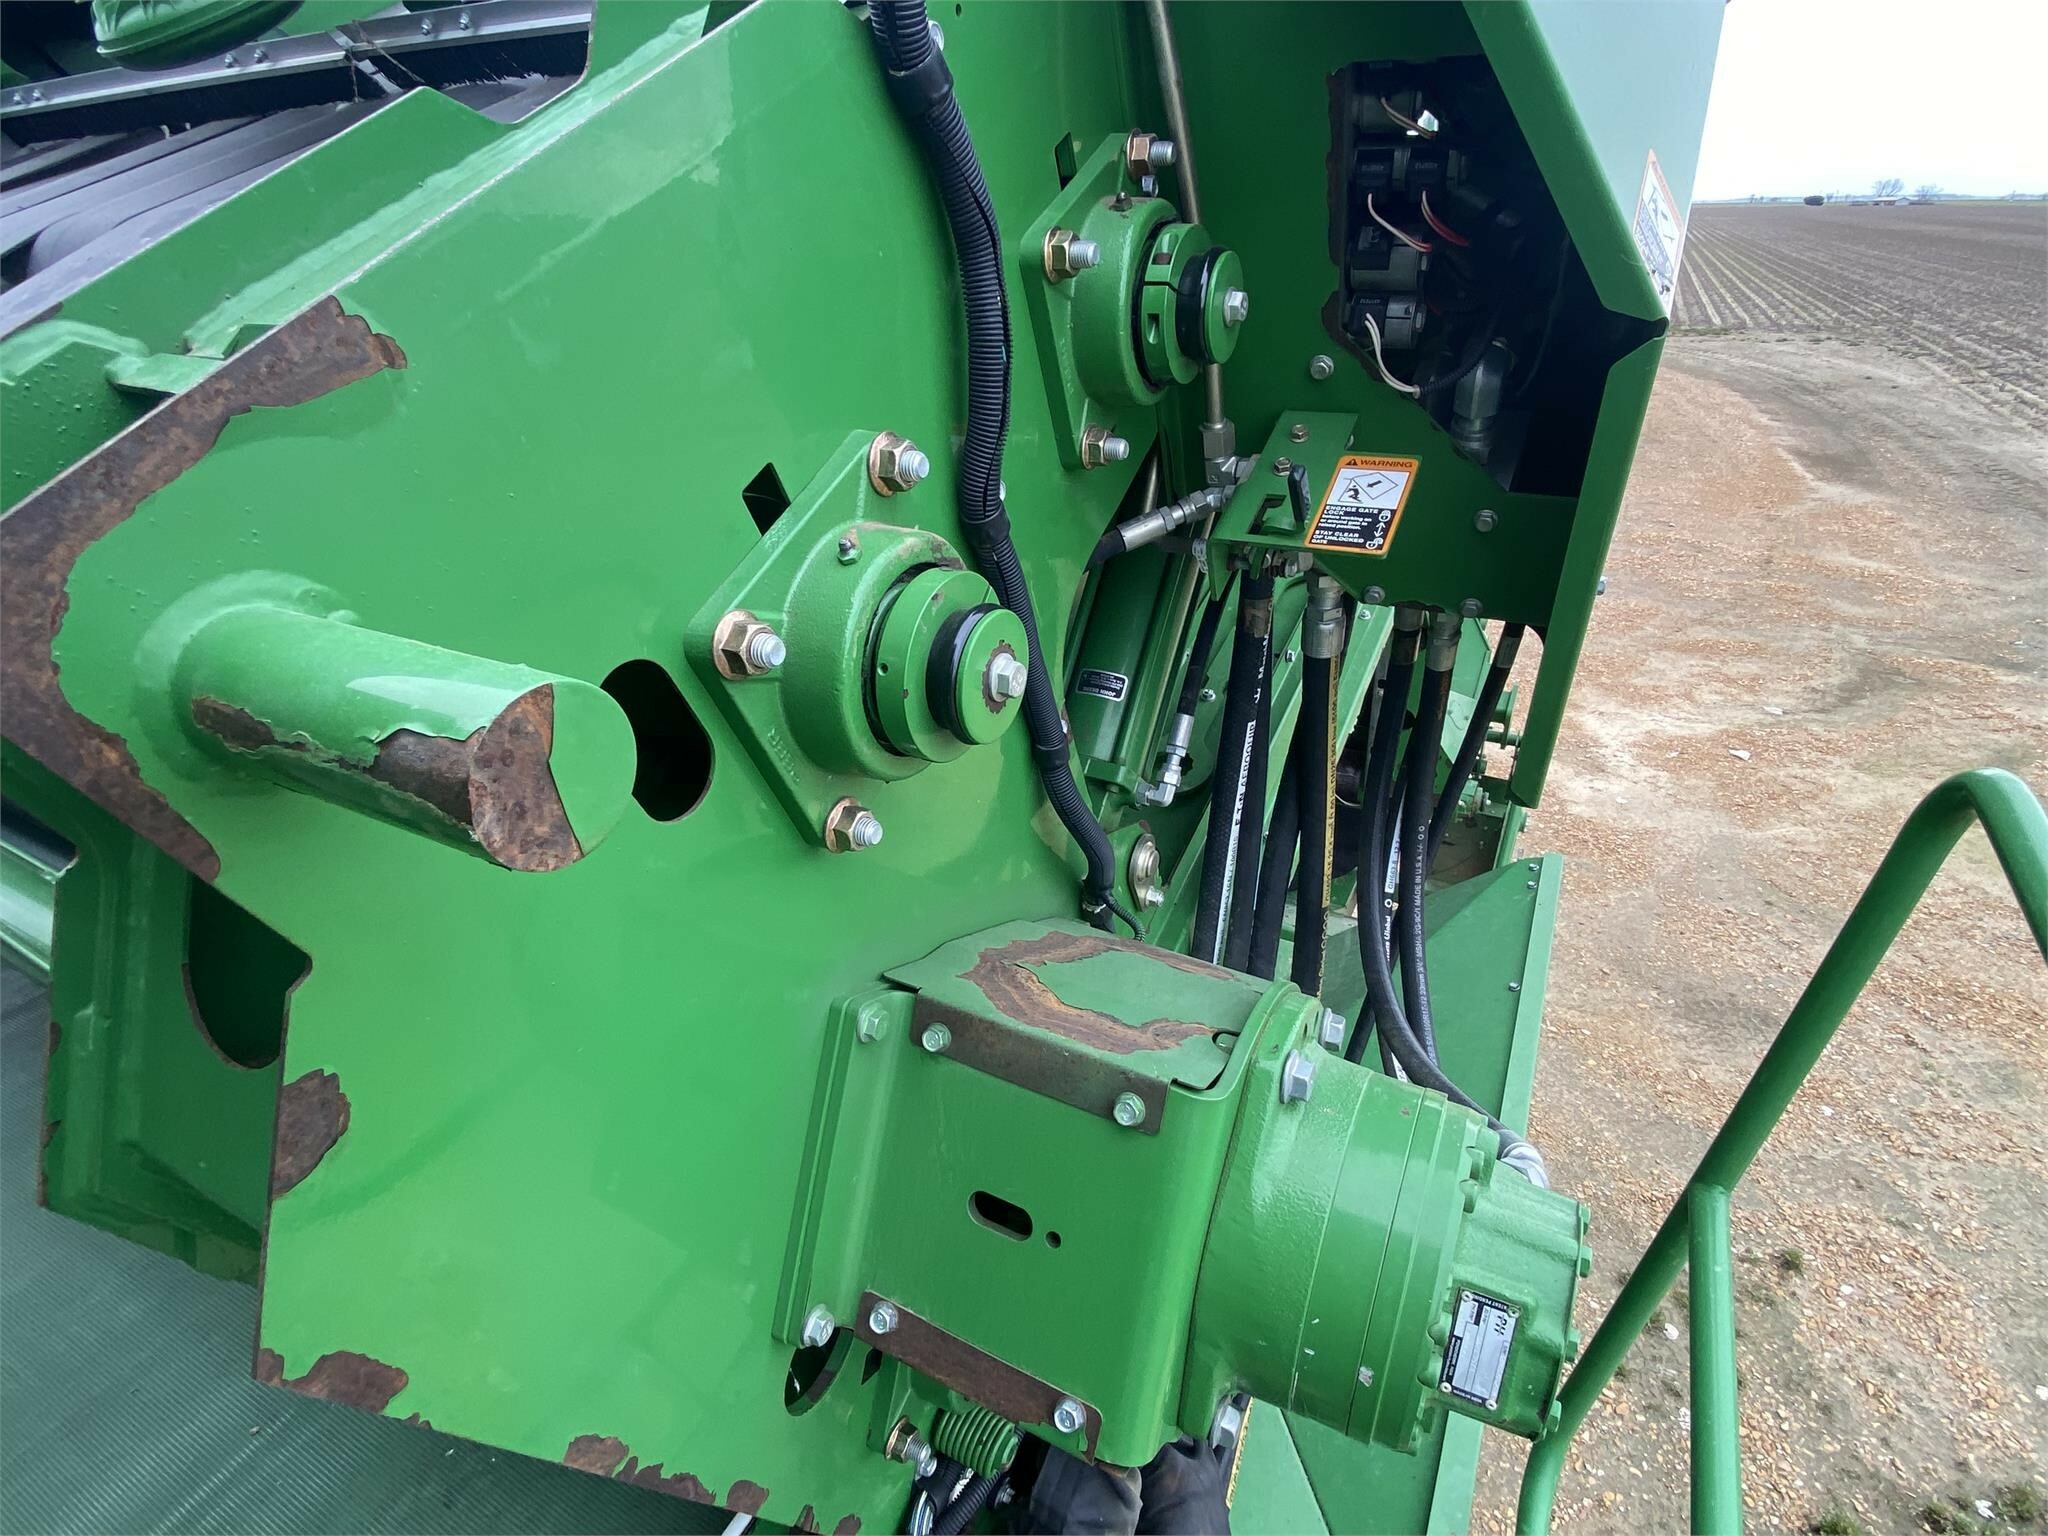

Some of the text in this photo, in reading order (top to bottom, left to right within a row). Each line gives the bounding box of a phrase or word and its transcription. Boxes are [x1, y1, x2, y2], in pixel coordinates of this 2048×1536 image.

[1360, 459, 1413, 468] WARNING
[1414, 854, 1423, 874] U.S.A.
[1414, 876, 1422, 884] IN
[1413, 884, 1422, 906] MADE
[1414, 936, 1423, 957] MSHA
